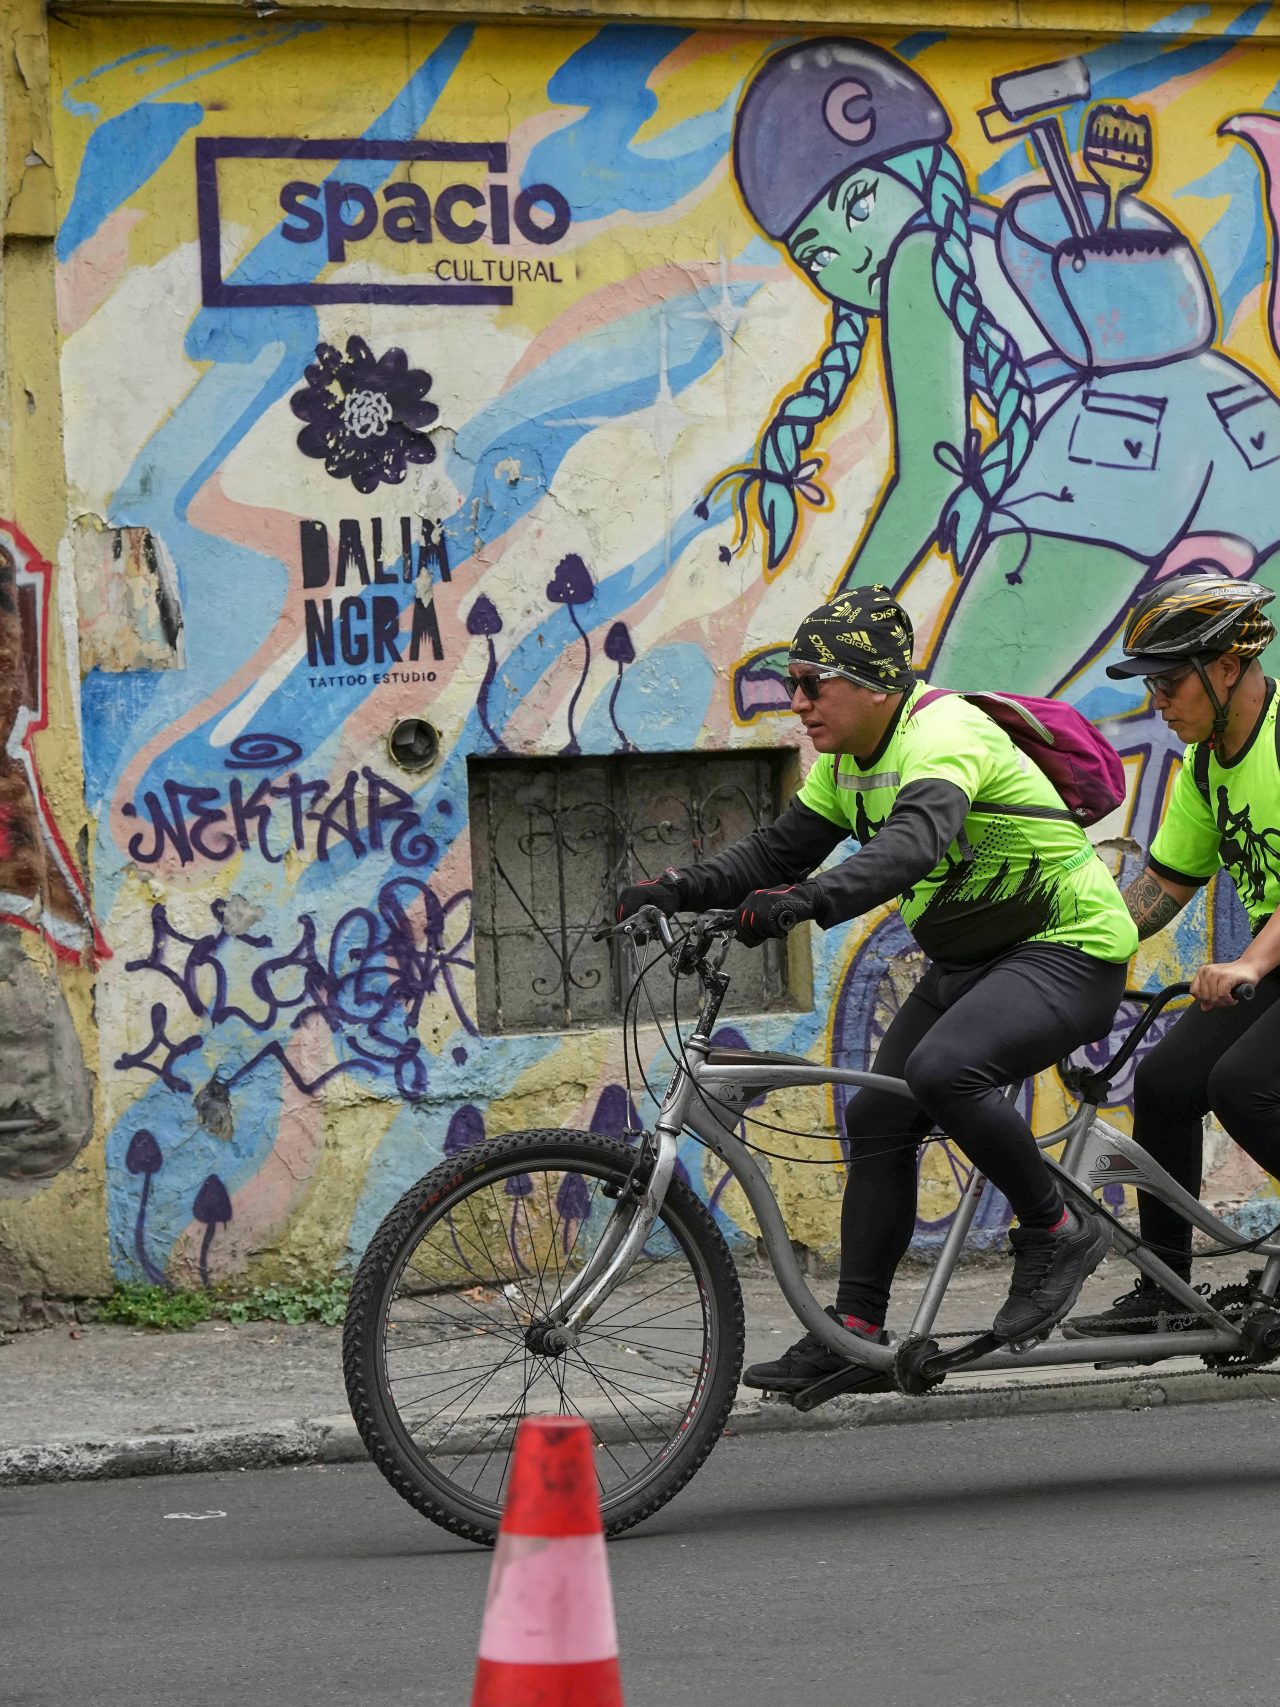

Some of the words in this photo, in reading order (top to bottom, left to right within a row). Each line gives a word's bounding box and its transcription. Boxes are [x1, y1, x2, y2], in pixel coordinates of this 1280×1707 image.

[279, 181, 571, 262] spacio
[435, 259, 563, 284] CULTURAL
[300, 516, 452, 589] DALIA
[803, 617, 842, 625] Champion
[847, 607, 862, 624] adidas
[304, 595, 444, 667] NGRA
[836, 634, 878, 654] adidas
[308, 674, 367, 689] TATTOO
[373, 671, 437, 684] ESTUDIO
